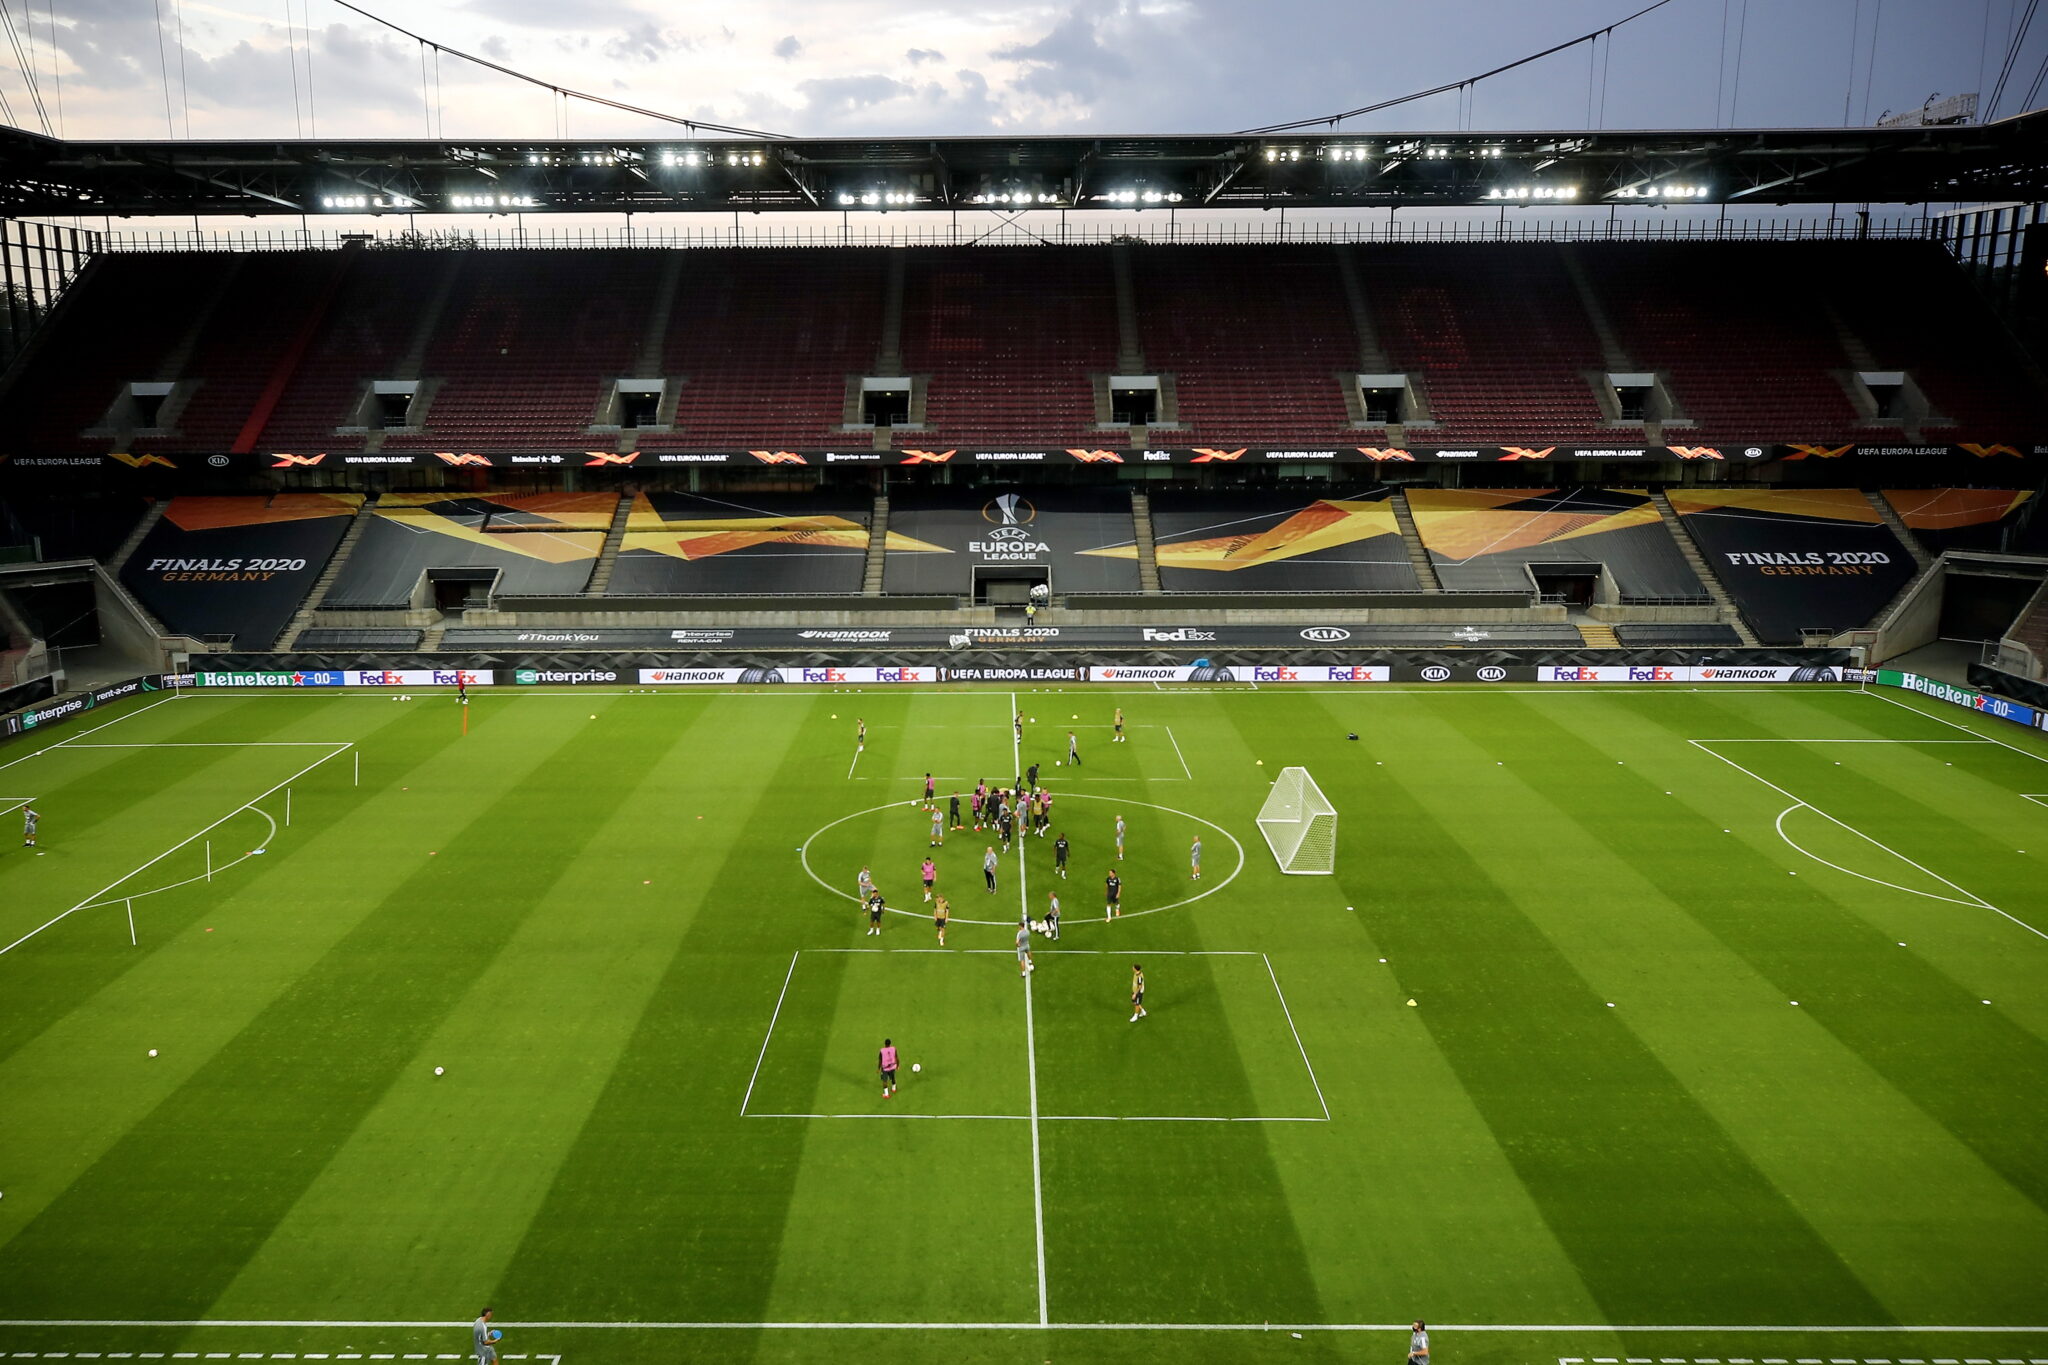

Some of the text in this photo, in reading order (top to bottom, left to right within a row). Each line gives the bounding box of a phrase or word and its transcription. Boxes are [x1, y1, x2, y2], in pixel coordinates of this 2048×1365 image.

[14, 457, 102, 466] UEFA EUROPA LEAGUE
[990, 528, 1027, 540] UEFA
[969, 541, 1051, 553] EUROPA
[146, 558, 306, 571] FINALS 2020
[1725, 552, 1890, 565] FINALS 2020
[162, 572, 275, 582] GERMANY
[1760, 565, 1873, 575] GERMANY
[517, 633, 599, 642] #ThankYou
[964, 628, 1060, 637] FINALS 2020
[1142, 628, 1216, 641] FedEx
[203, 671, 289, 686] Heineken
[360, 671, 404, 685] FedEx
[521, 669, 617, 685] enterprise
[803, 667, 846, 682] FedEx
[876, 667, 920, 682] FedEx
[950, 668, 1075, 679] UEFA EUROPA LEAGUE
[1254, 666, 1298, 681] FedEx
[1328, 666, 1372, 681] FedEx
[1554, 666, 1598, 681] FedEx
[1629, 666, 1673, 681] FedEx
[96, 682, 138, 702] rent-a-car
[1901, 672, 1972, 708] Heineken
[24, 699, 82, 726] enterprise
